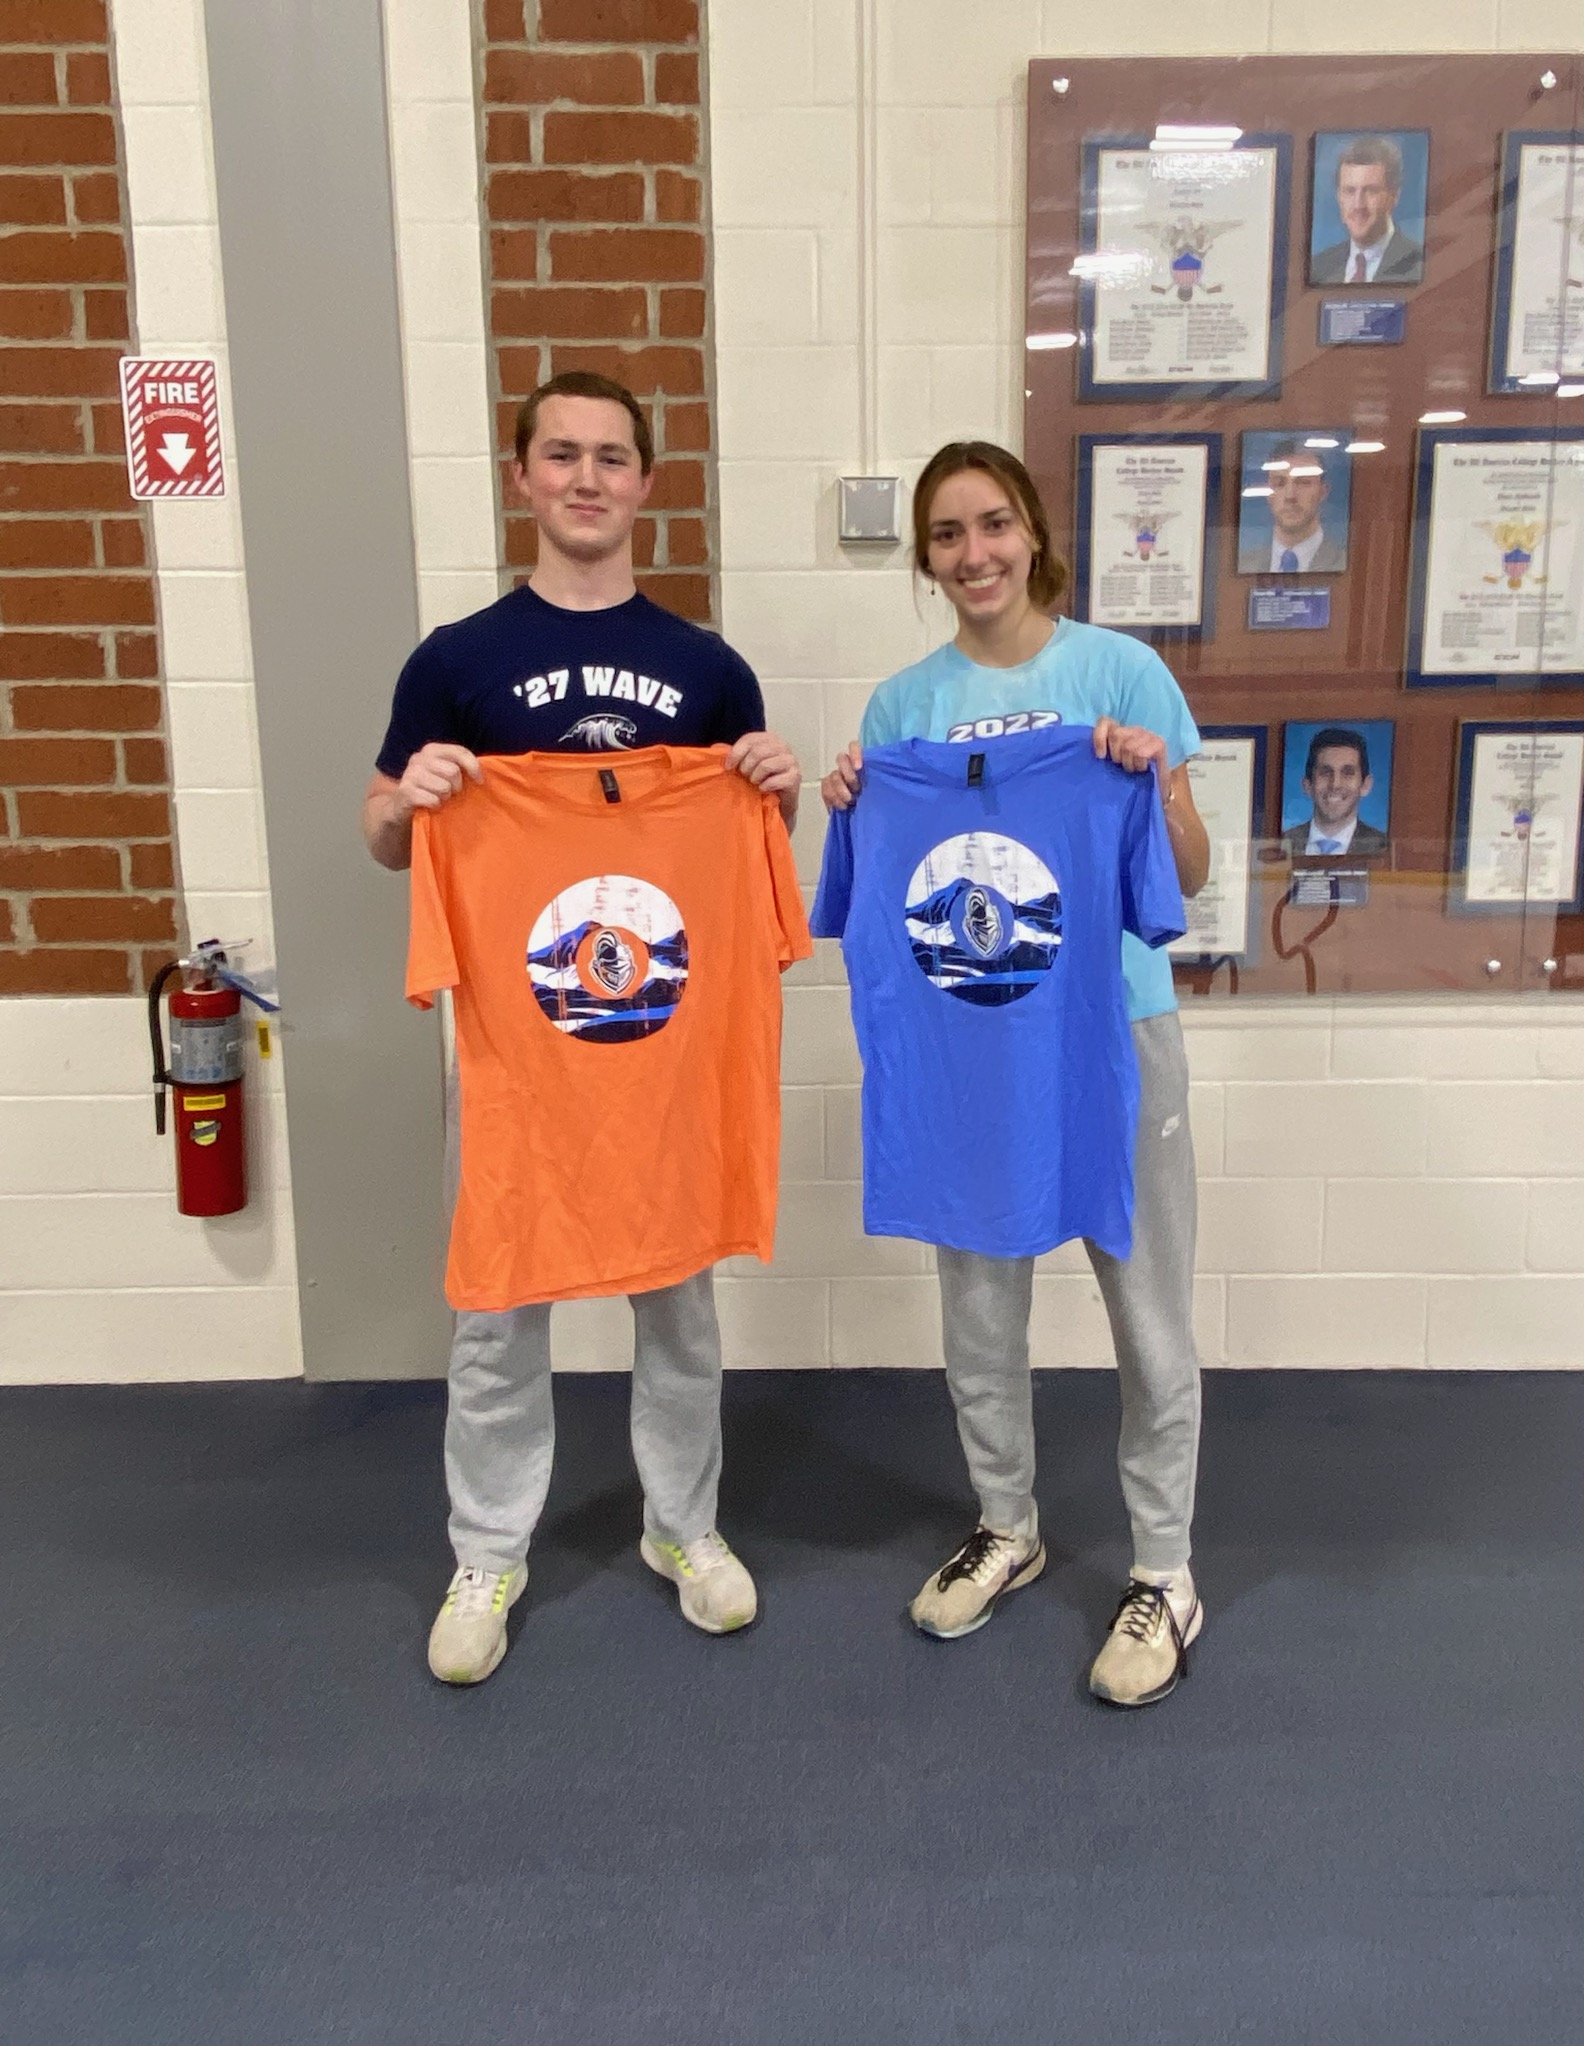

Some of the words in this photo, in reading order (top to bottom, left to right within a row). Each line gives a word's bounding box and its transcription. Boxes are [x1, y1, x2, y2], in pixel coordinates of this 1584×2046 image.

[144, 381, 200, 405] FIRE
[512, 668, 570, 708] '27
[581, 666, 683, 718] WAVE
[946, 709, 1062, 743] 2022
